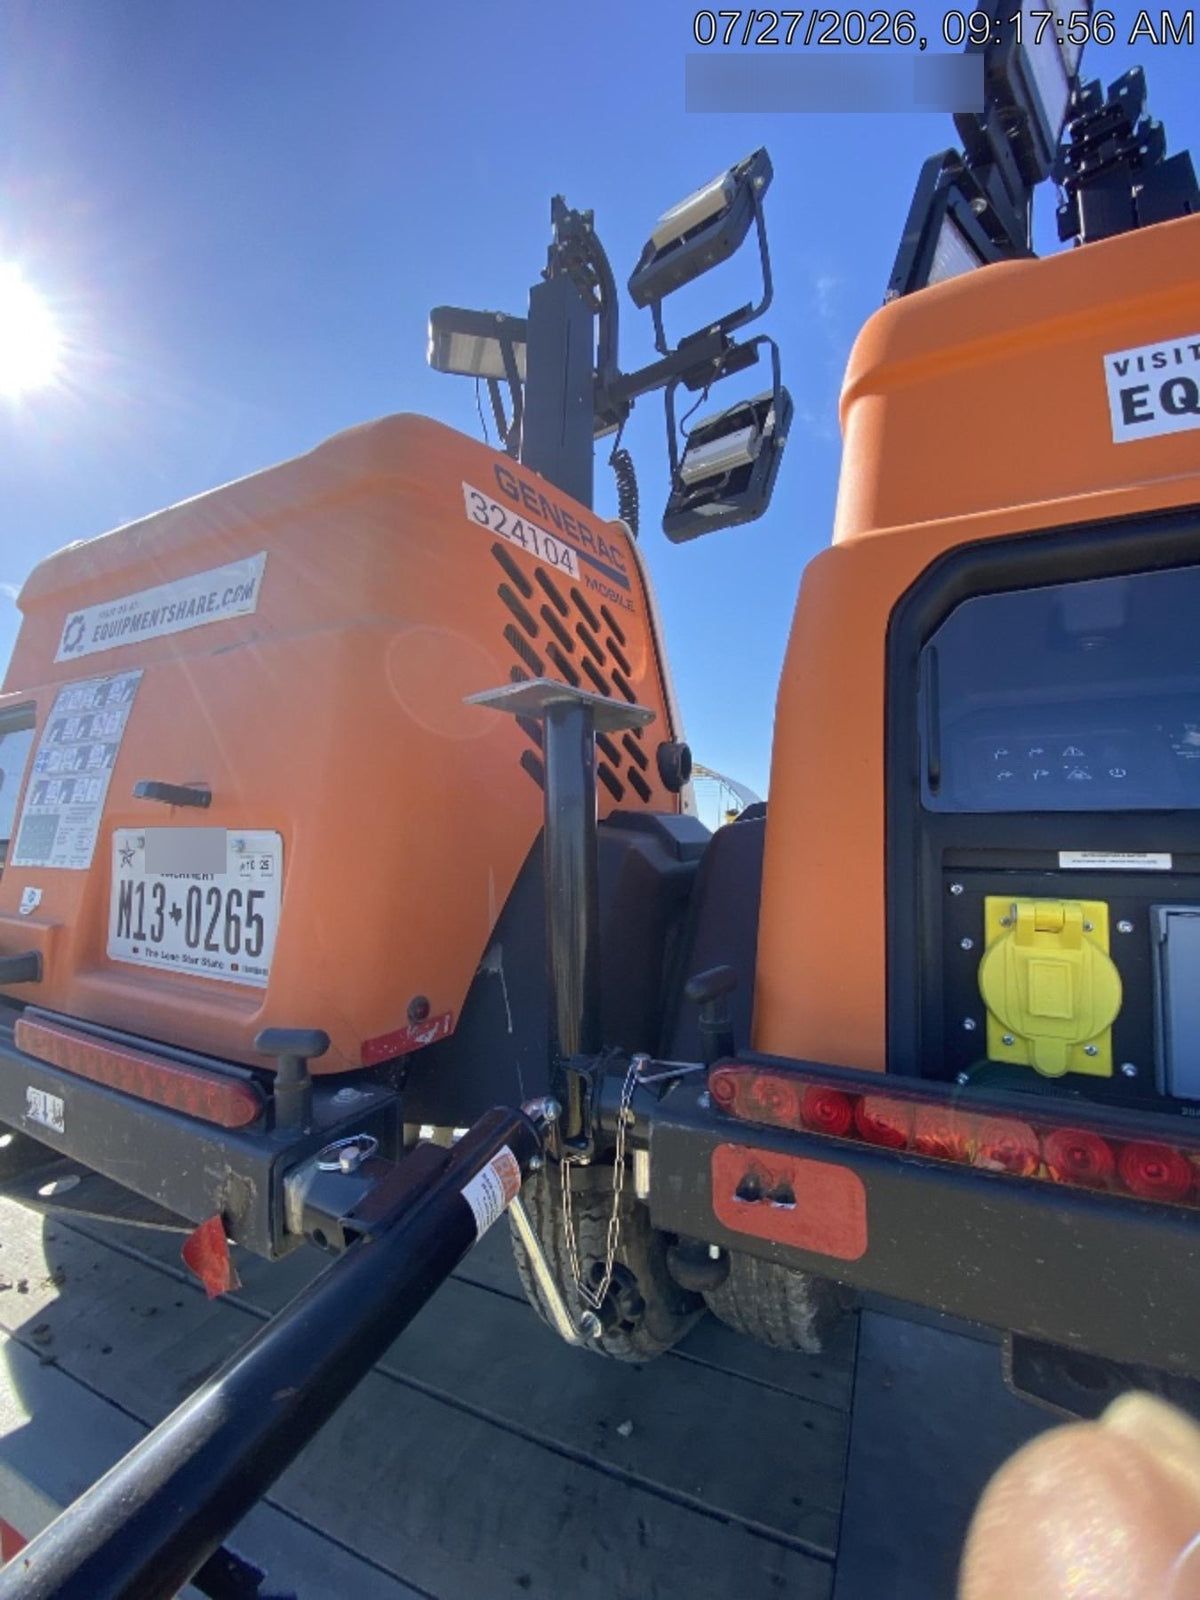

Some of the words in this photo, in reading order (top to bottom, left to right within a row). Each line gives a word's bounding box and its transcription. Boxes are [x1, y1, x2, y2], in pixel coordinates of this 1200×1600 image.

[1113, 342, 1200, 377] VISIT
[471, 492, 575, 574] 324104
[494, 463, 627, 572] GENERAC
[92, 578, 256, 642] EQUIPMENTSHARE.COM
[584, 574, 636, 612] MOBILE
